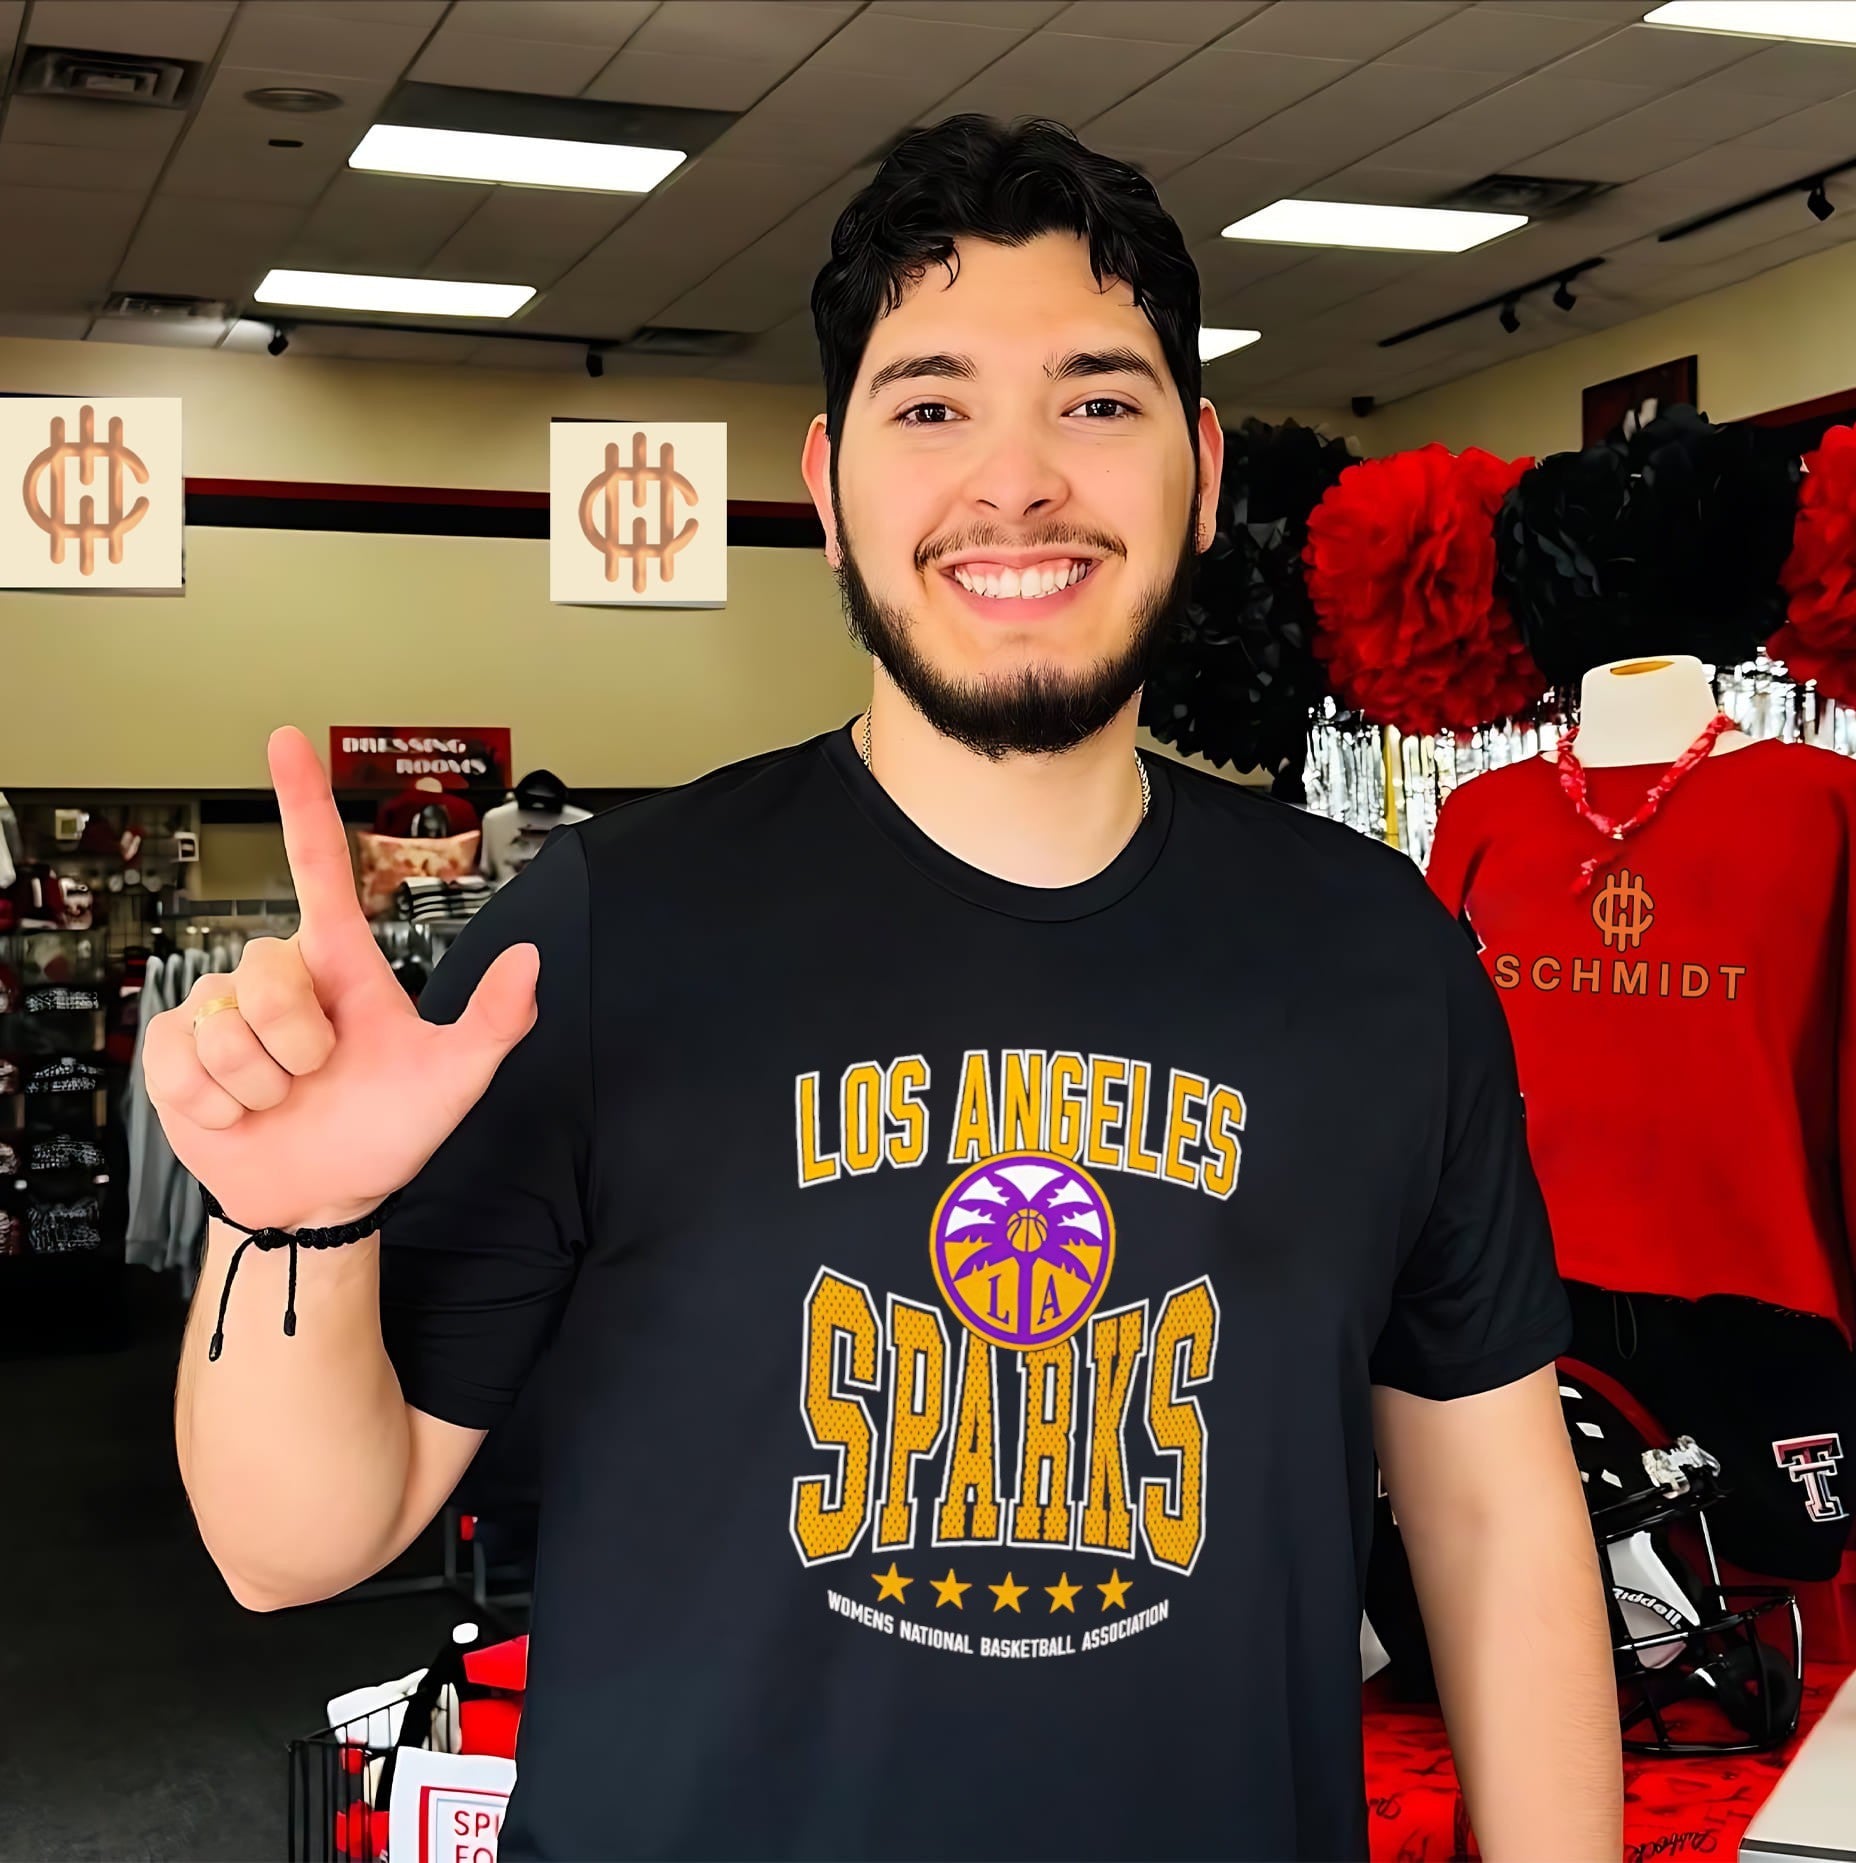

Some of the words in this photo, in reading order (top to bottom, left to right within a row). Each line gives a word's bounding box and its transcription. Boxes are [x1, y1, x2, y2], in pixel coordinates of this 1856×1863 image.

[342, 737, 467, 753] DRESSING
[396, 759, 487, 775] ROOMS
[1494, 954, 1747, 1001] SCHMIDT
[795, 1054, 931, 1188] LOS
[947, 1049, 1247, 1201] ANGELES
[789, 1265, 1220, 1577] SPARKS
[827, 1590, 894, 1634] WOMENS
[900, 1621, 973, 1655] NATIONAL
[980, 1636, 1076, 1658] BASKETBALL
[1082, 1599, 1169, 1651] ASSOCIATION
